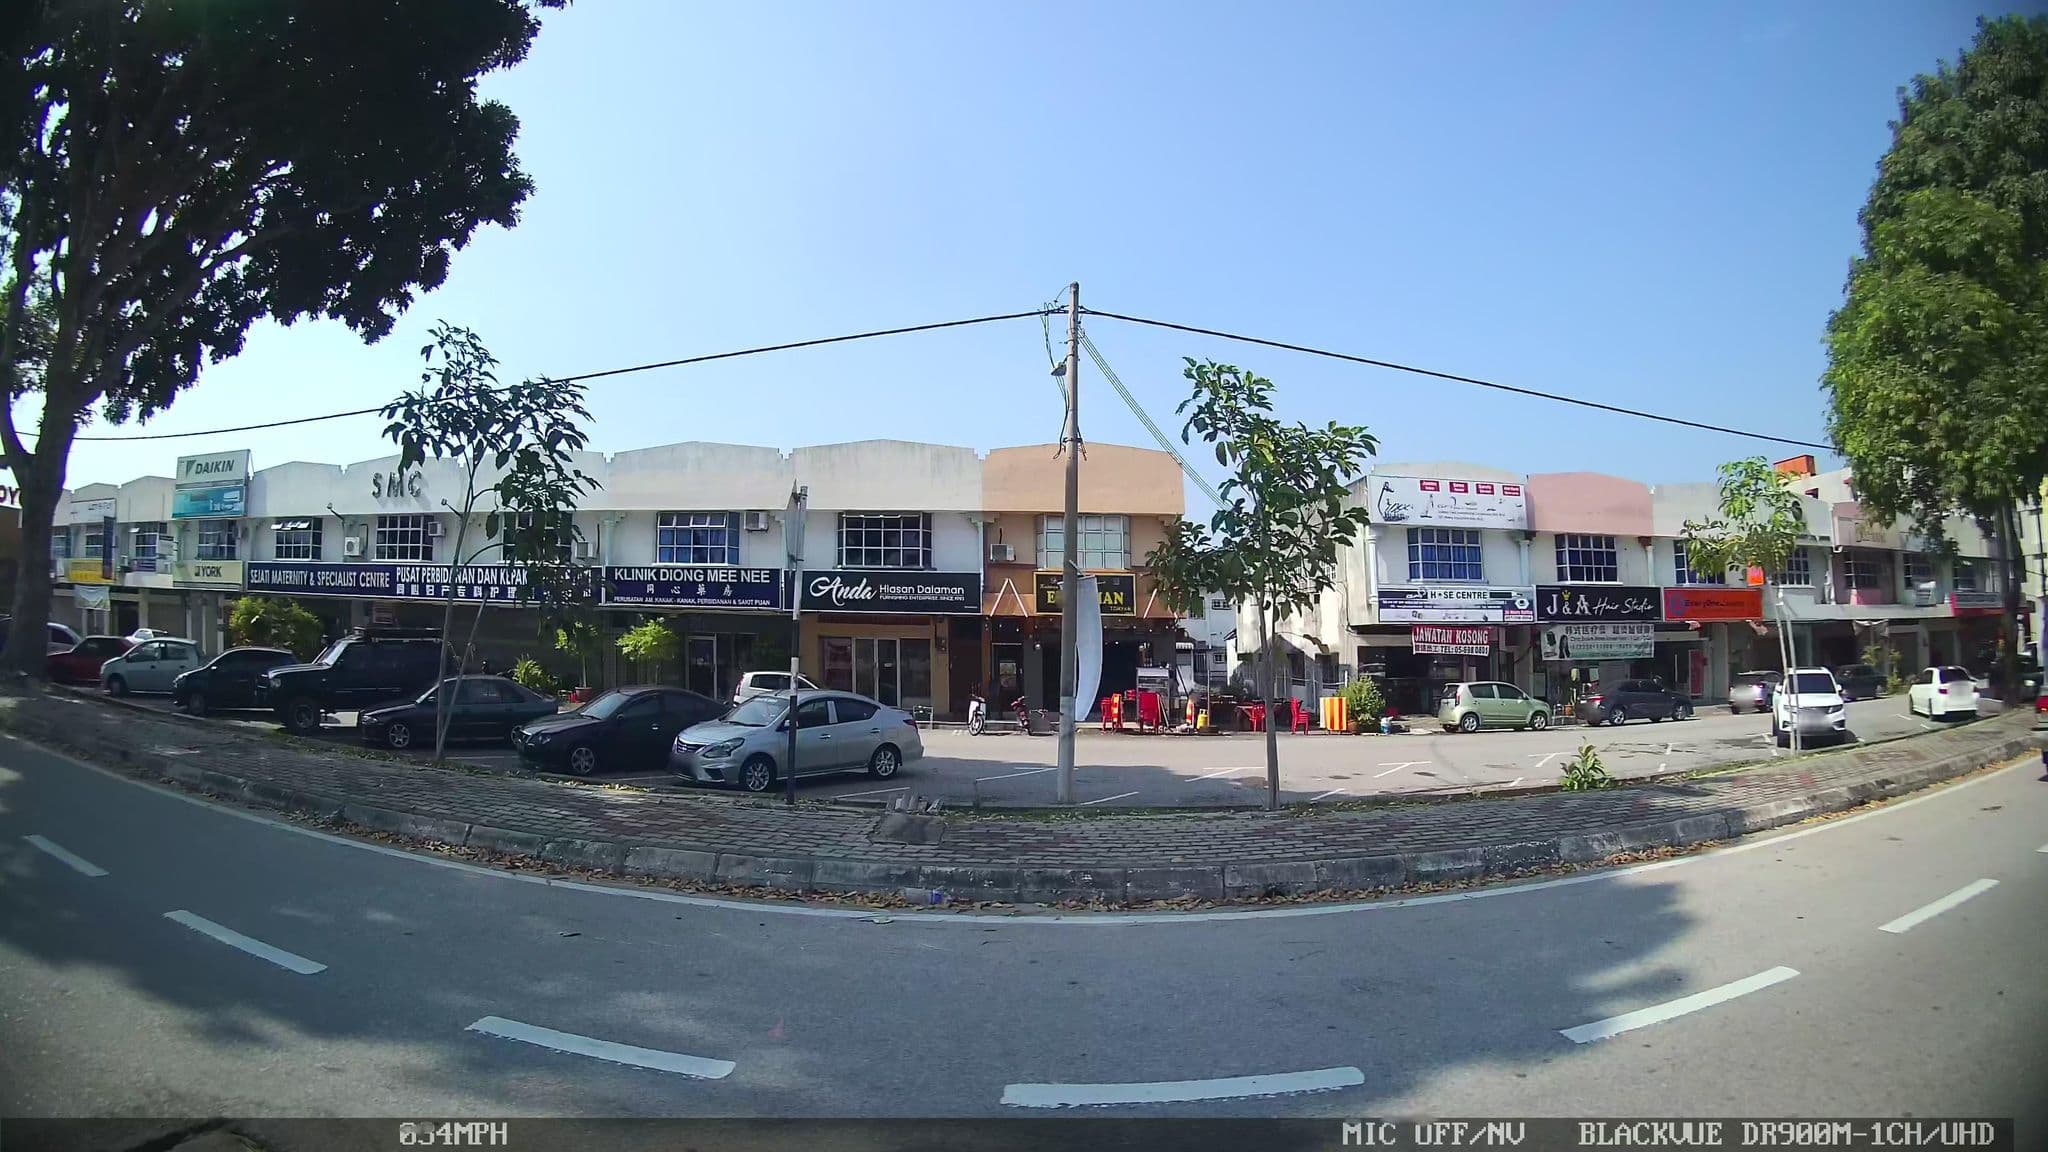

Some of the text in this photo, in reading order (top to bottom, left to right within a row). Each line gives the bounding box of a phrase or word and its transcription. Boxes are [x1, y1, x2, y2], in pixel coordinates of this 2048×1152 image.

[195, 460, 234, 475] DAIKIN
[372, 470, 422, 498] SMC
[201, 565, 222, 578] YORK
[250, 569, 390, 588] SEJATI MATERNITY & SPECIALIST CENTRE
[396, 566, 421, 583] PUSAT
[477, 568, 498, 585] DAN
[614, 568, 770, 583] KLINIK DIONG MEE NEE
[809, 575, 877, 607] Anda
[879, 584, 964, 595] Hiasan Dalaman
[1456, 591, 1488, 600] CENTRE
[1592, 597, 1619, 615] Hair
[1621, 598, 1654, 614] Studio
[1415, 627, 1488, 645] JAWATAN KOSONG
